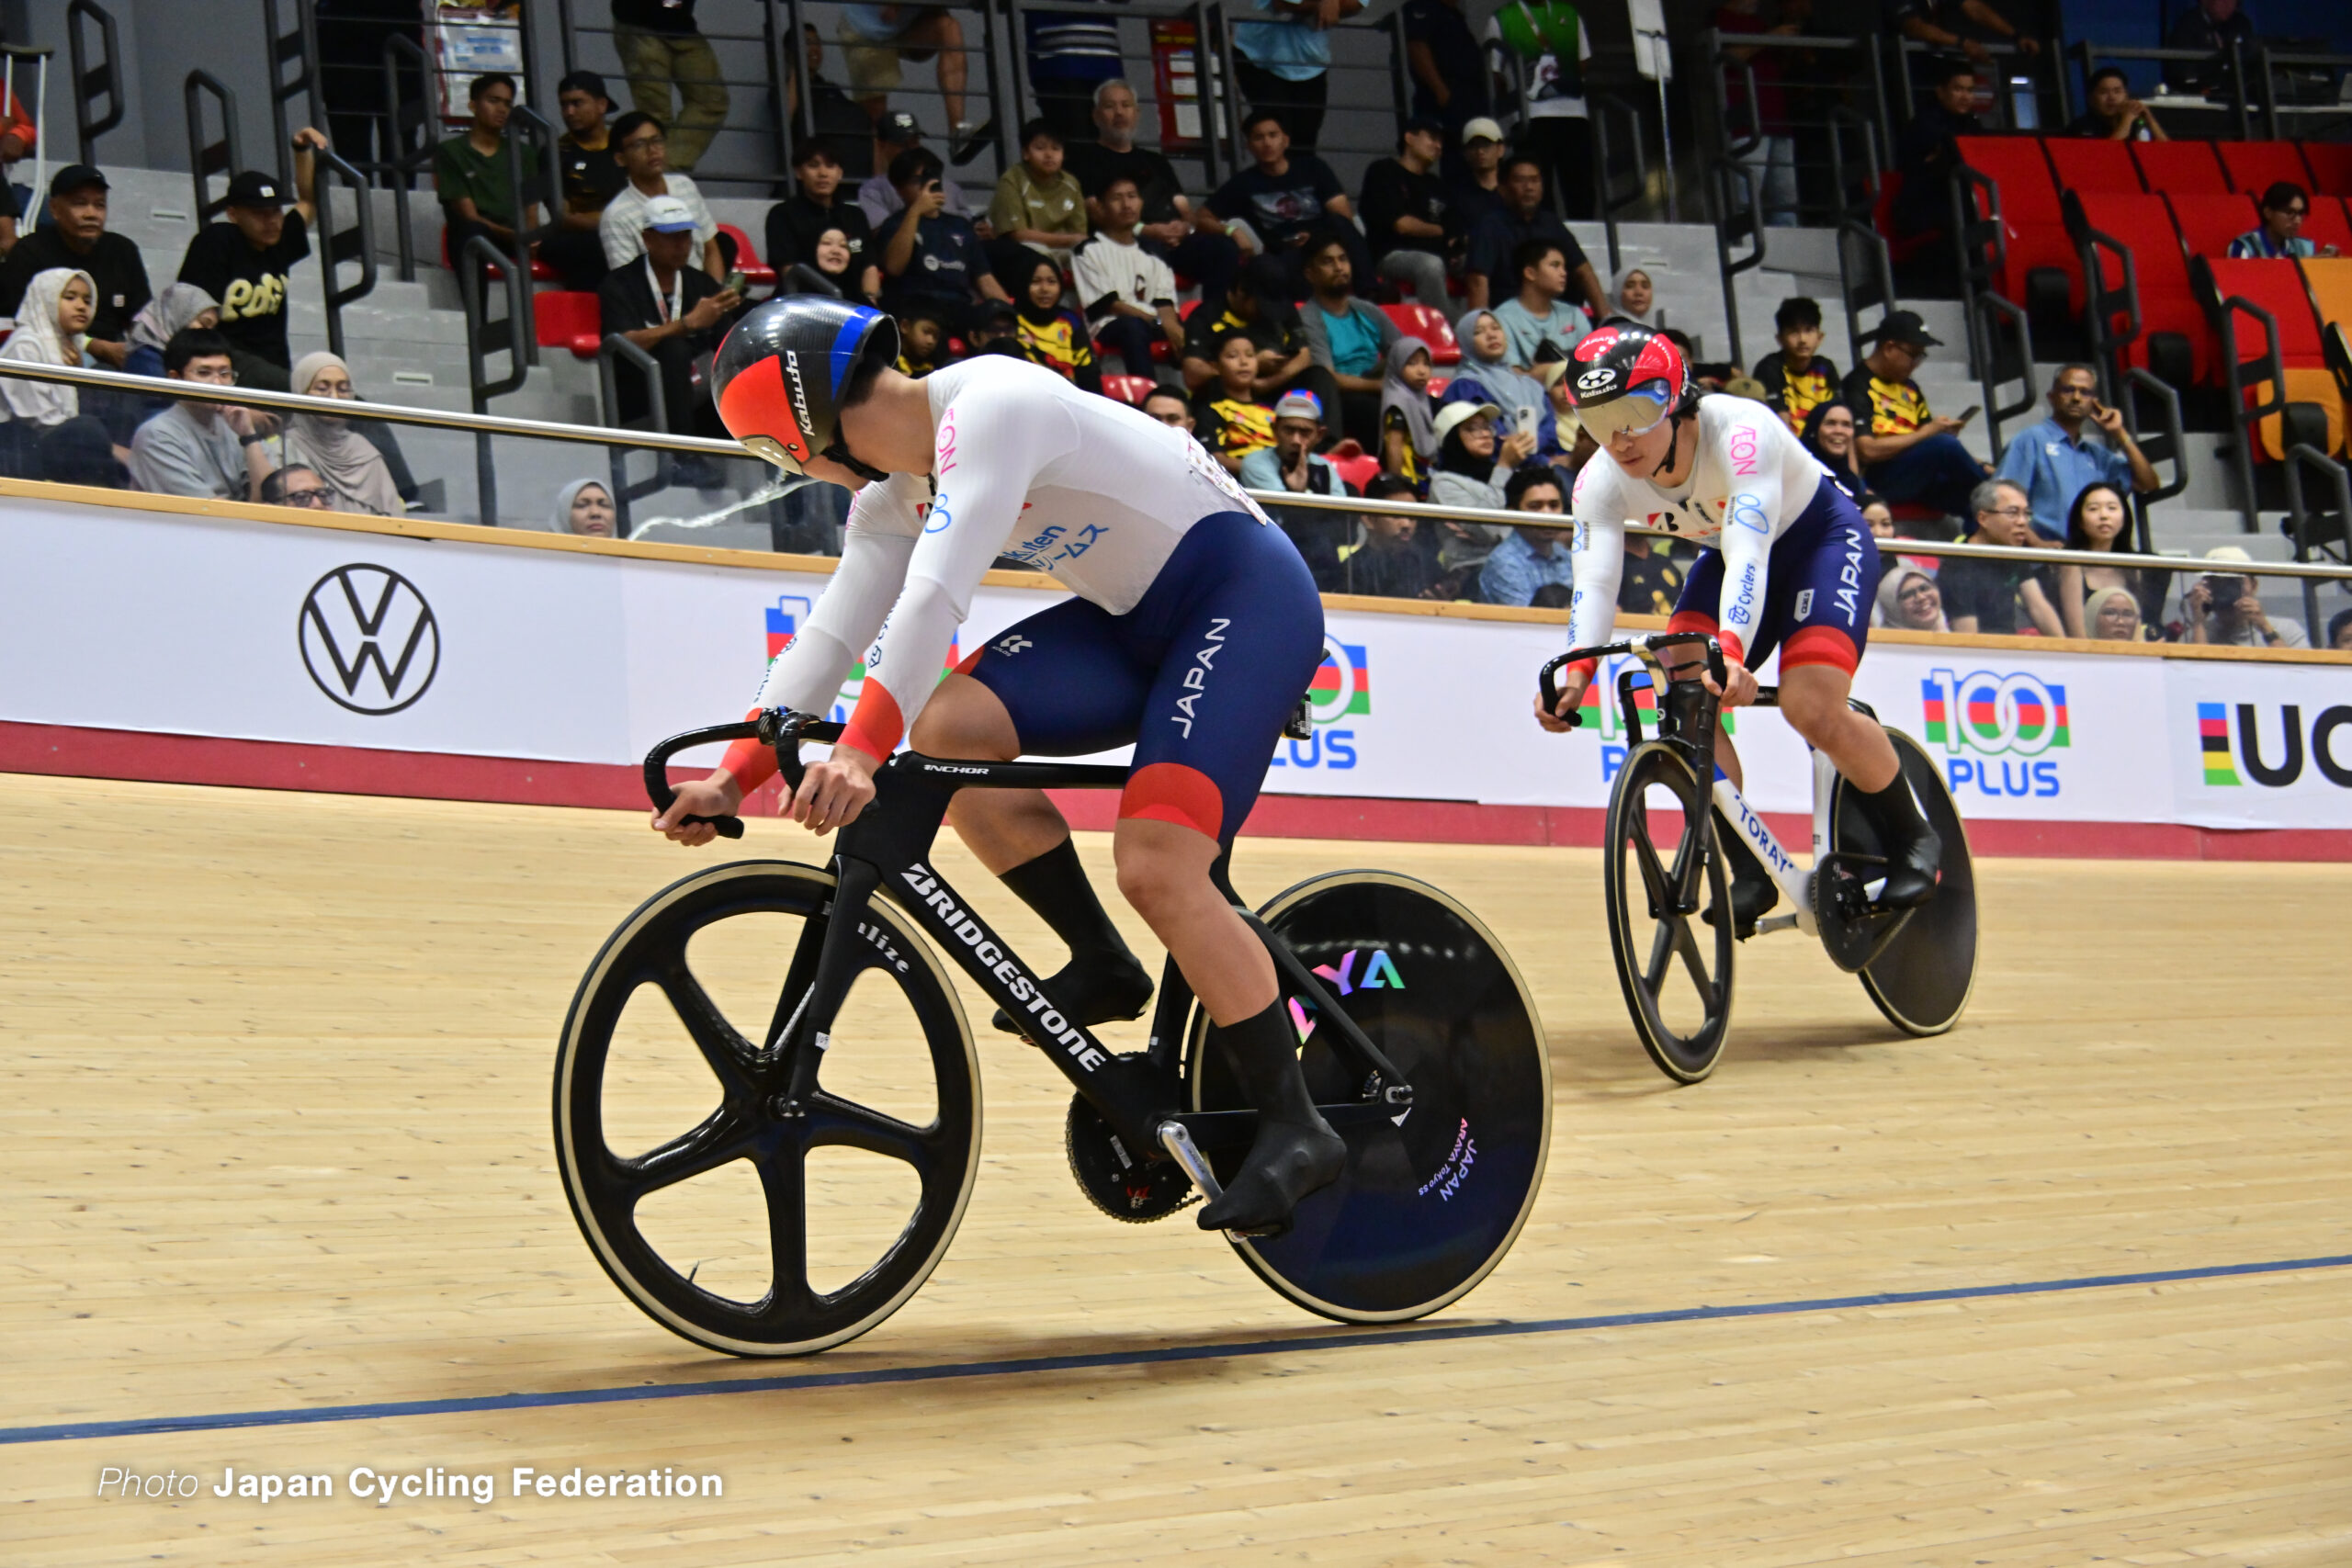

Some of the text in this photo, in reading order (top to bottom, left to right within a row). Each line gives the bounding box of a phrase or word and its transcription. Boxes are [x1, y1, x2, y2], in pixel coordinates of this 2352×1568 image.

[786, 350, 815, 436] Kabuto
[1738, 563, 1756, 605] Cyclers
[1834, 528, 1862, 626] JAPAN
[1171, 618, 1231, 739] JAPAN
[1930, 668, 2058, 757] 100
[1947, 758, 2060, 797] PLUS
[900, 863, 1106, 1072] BRIDGESTONE
[1439, 1138, 1477, 1201] JAPAN
[1448, 1117, 1468, 1162] ARAYA
